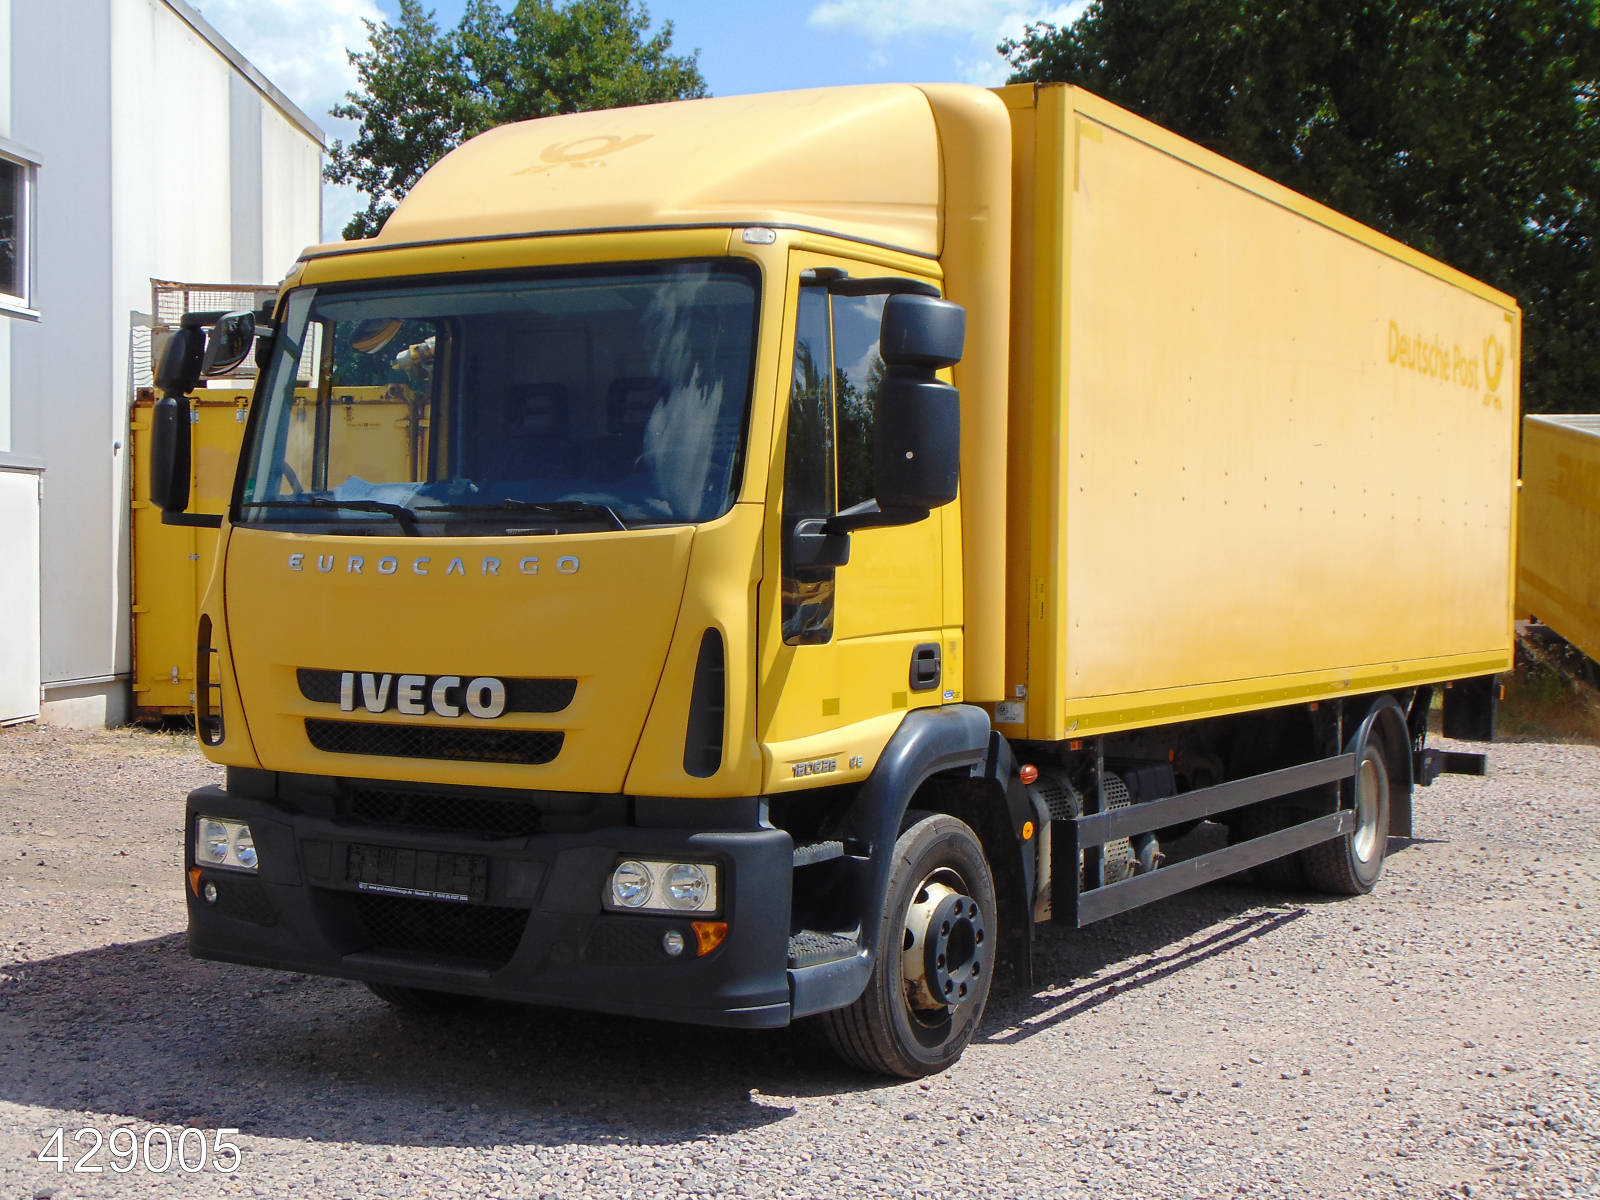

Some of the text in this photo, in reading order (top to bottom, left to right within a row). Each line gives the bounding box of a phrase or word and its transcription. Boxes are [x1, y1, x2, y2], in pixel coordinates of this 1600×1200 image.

[1388, 319, 1479, 392] Deutsche Post
[288, 552, 580, 576] EUROCARGO
[340, 672, 506, 719] IVECO
